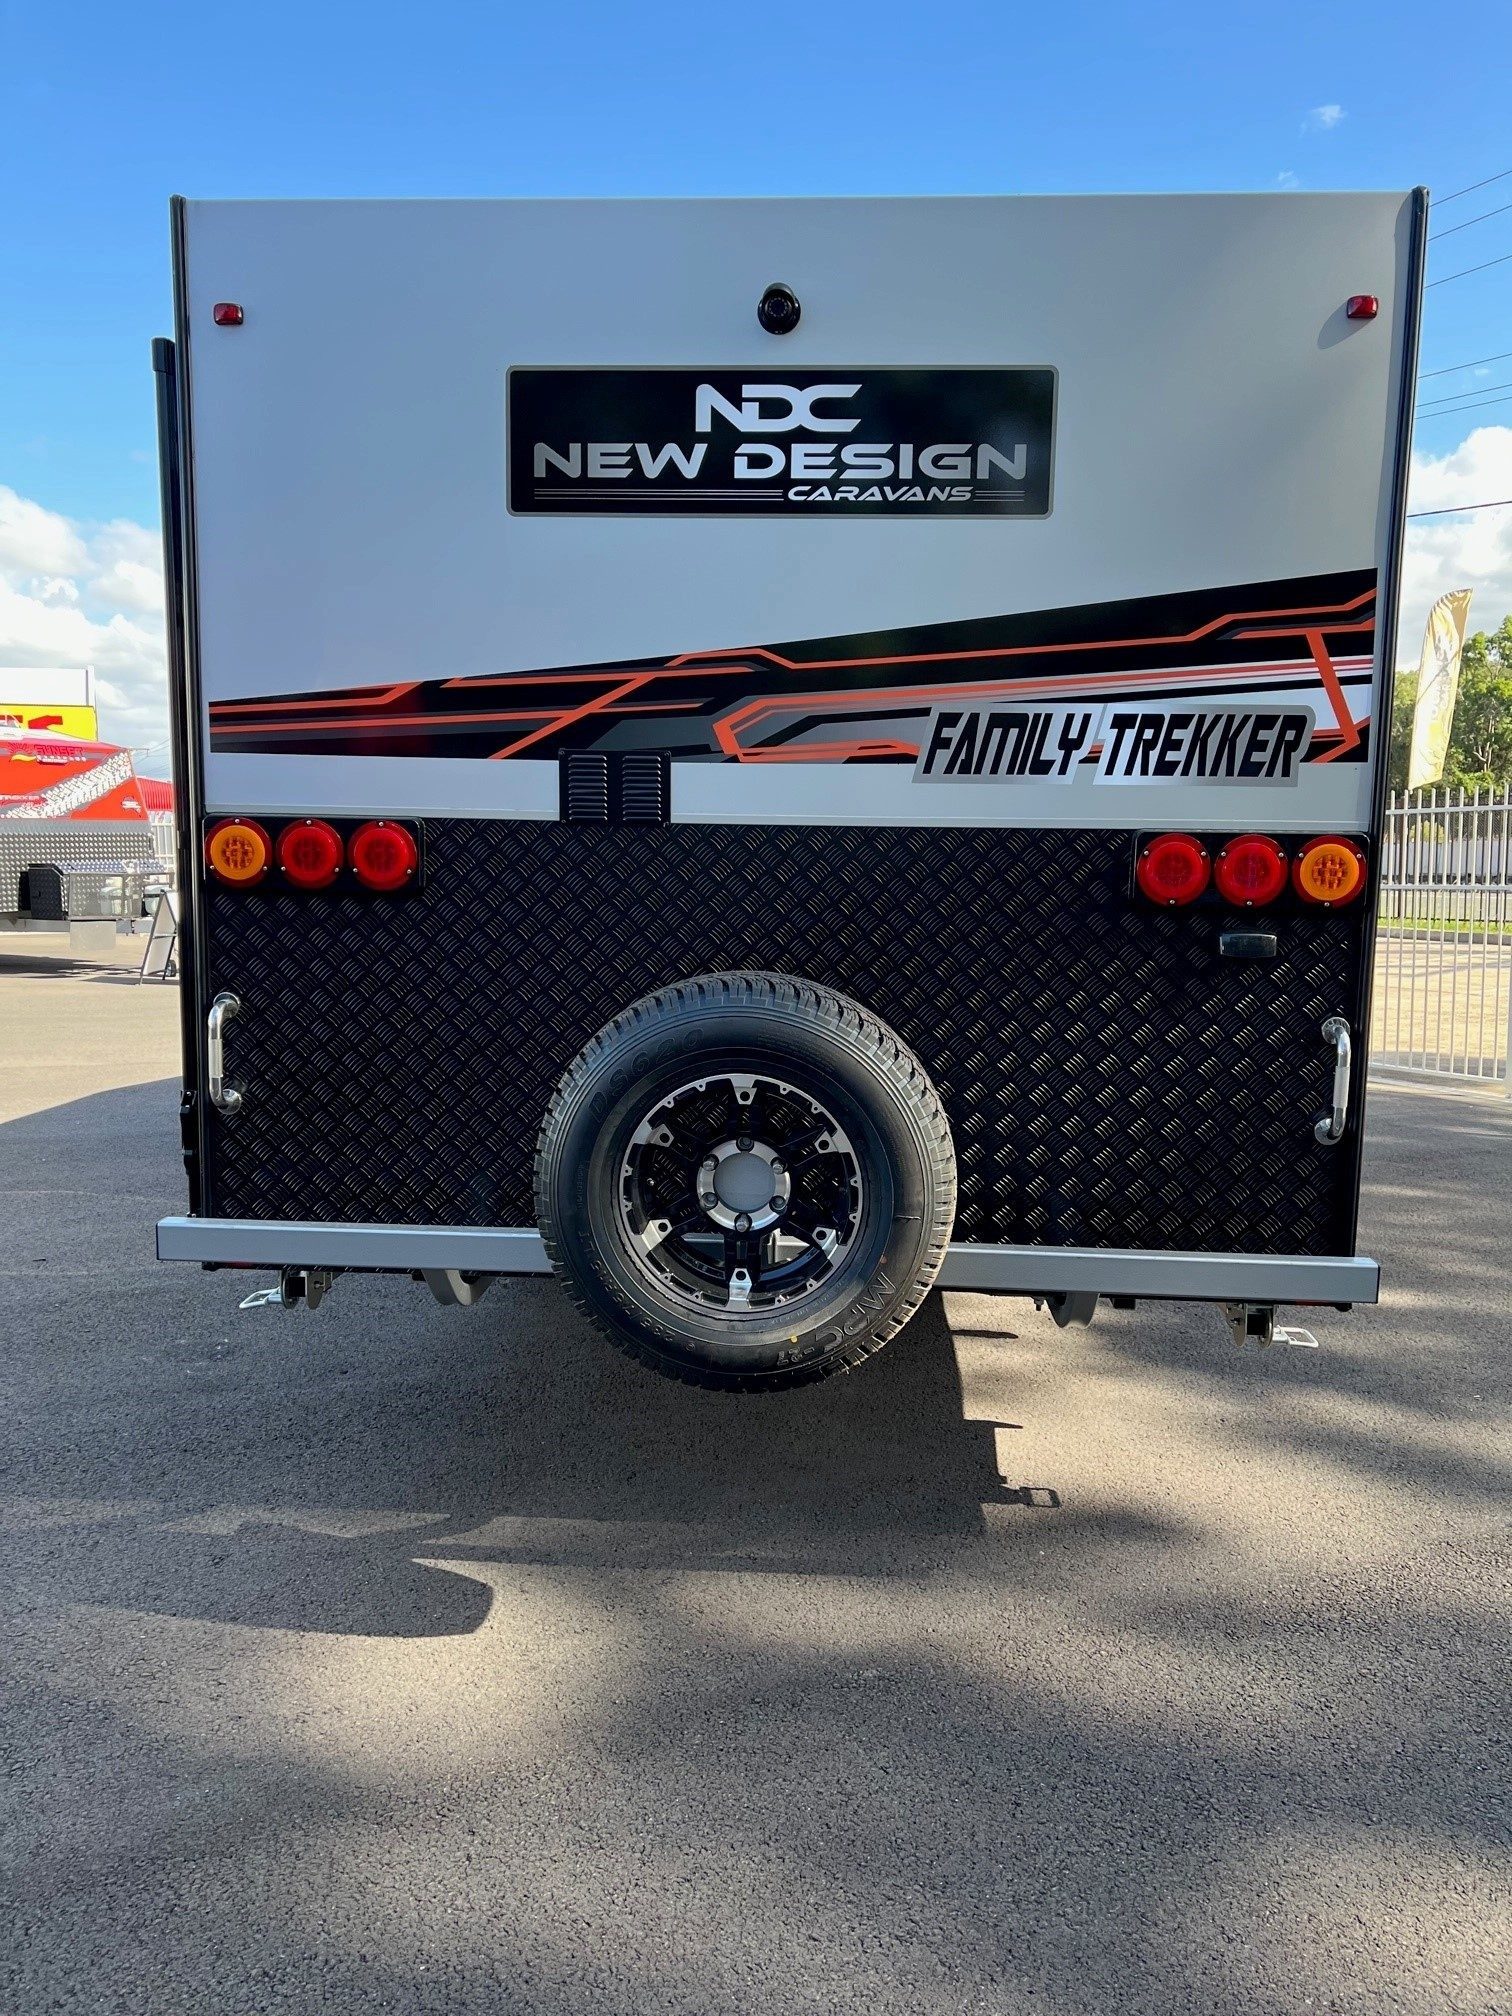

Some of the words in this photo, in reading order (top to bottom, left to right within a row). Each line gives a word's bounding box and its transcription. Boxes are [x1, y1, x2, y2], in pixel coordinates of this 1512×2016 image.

[695, 384, 862, 432] NDC
[534, 442, 708, 479] NEW
[734, 443, 1026, 479] DESIGN
[788, 486, 973, 501] CARAVANS
[922, 712, 1092, 776] FAMILY
[1104, 713, 1308, 778] TREKKER
